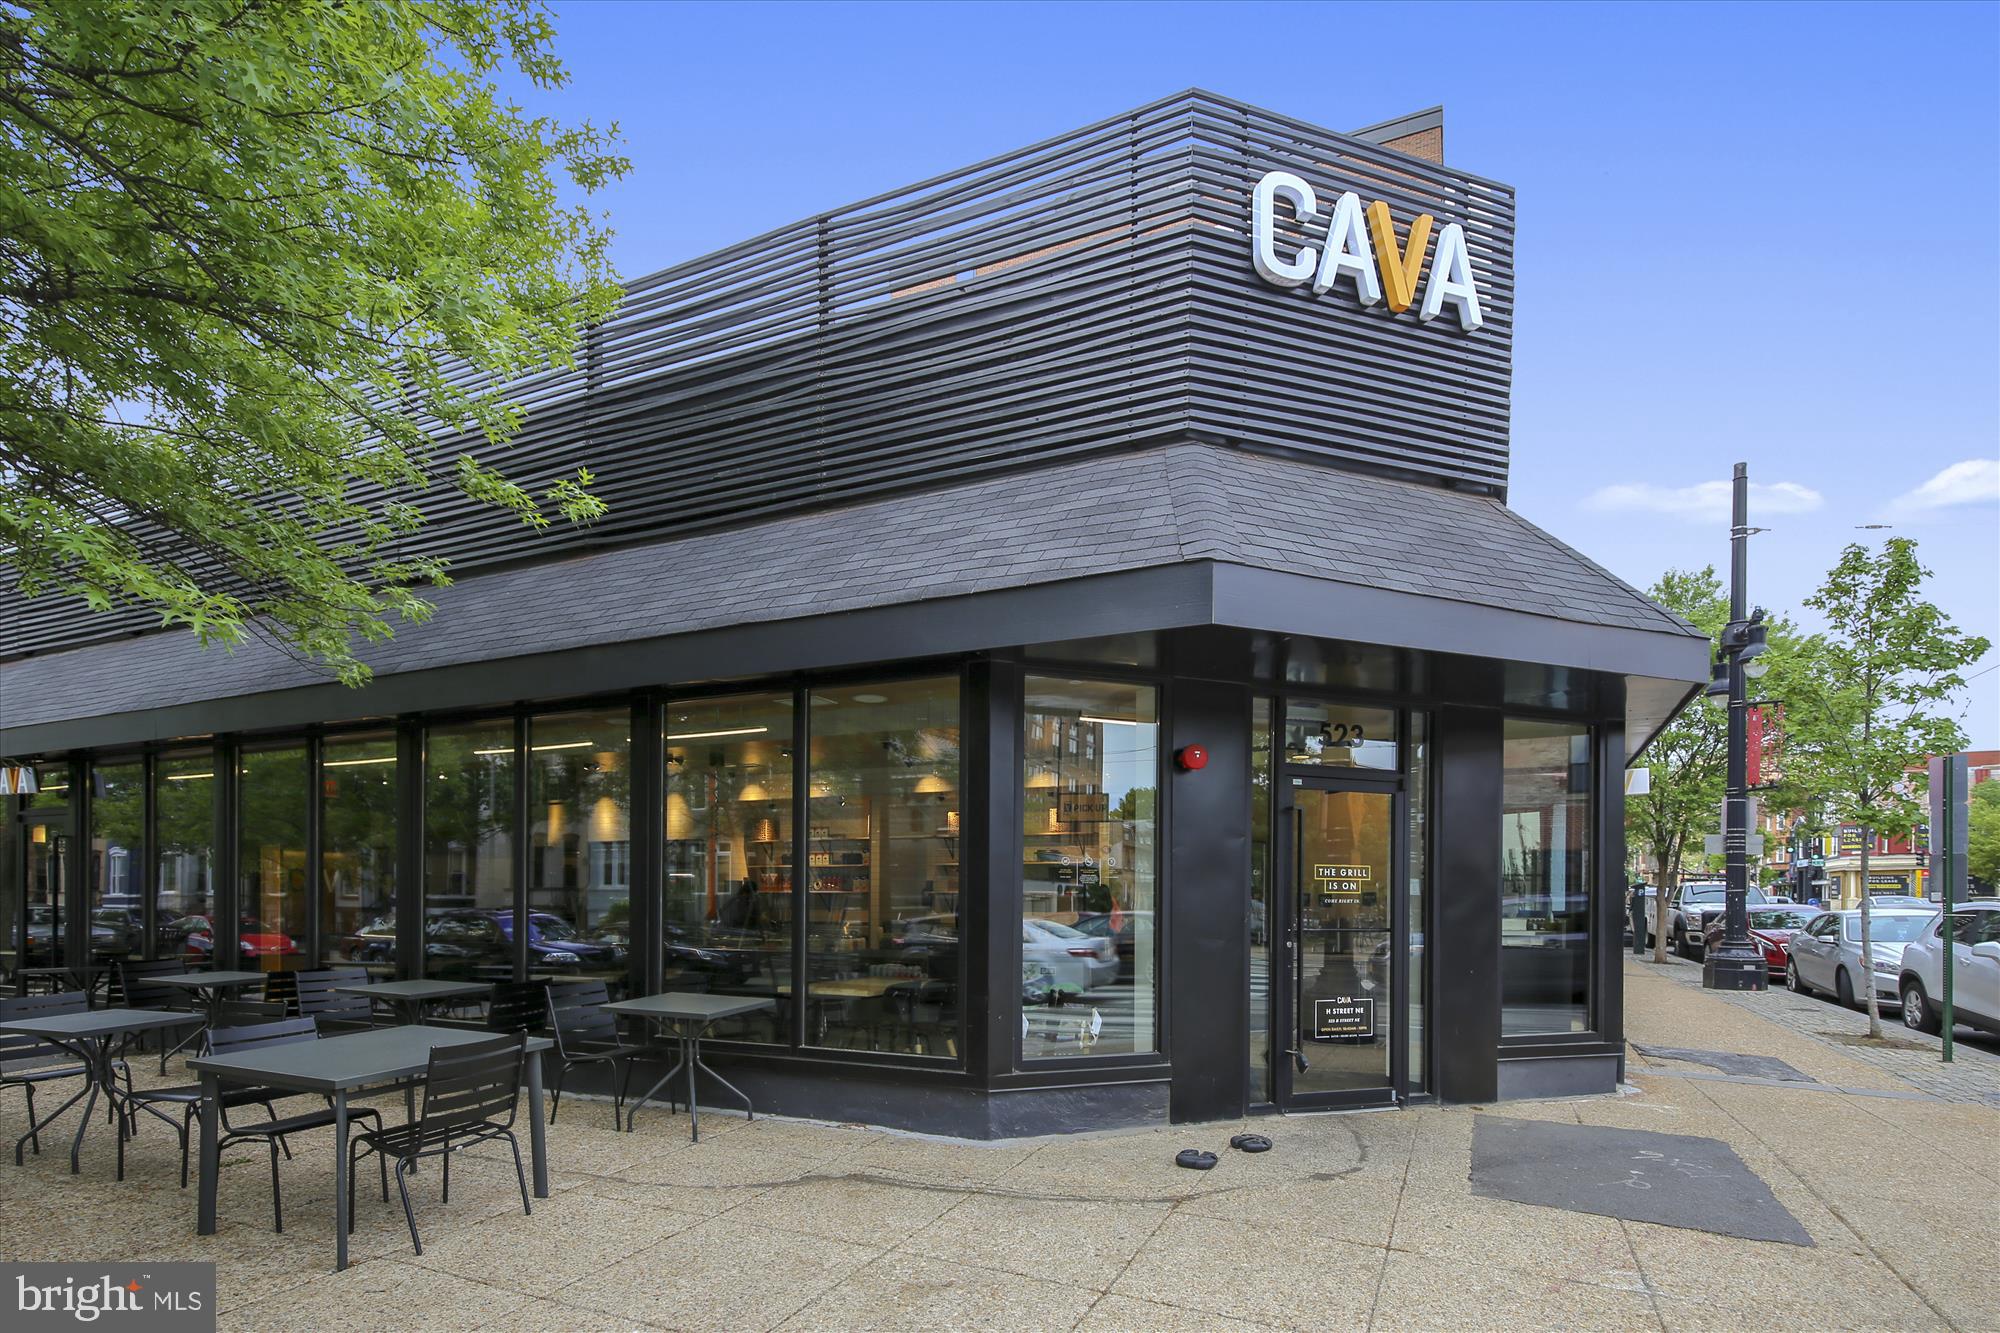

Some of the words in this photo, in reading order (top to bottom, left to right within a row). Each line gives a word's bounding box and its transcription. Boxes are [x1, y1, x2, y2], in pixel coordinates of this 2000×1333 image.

[1252, 171, 1483, 331] CAVA
[1319, 722, 1364, 747] 523
[1318, 868, 1336, 876] THE
[1340, 868, 1367, 877] GRILL
[1329, 882, 1338, 890] IS
[1342, 882, 1357, 890] ON
[1337, 996, 1352, 1004] CAVA
[1332, 1007, 1354, 1015] STREET
